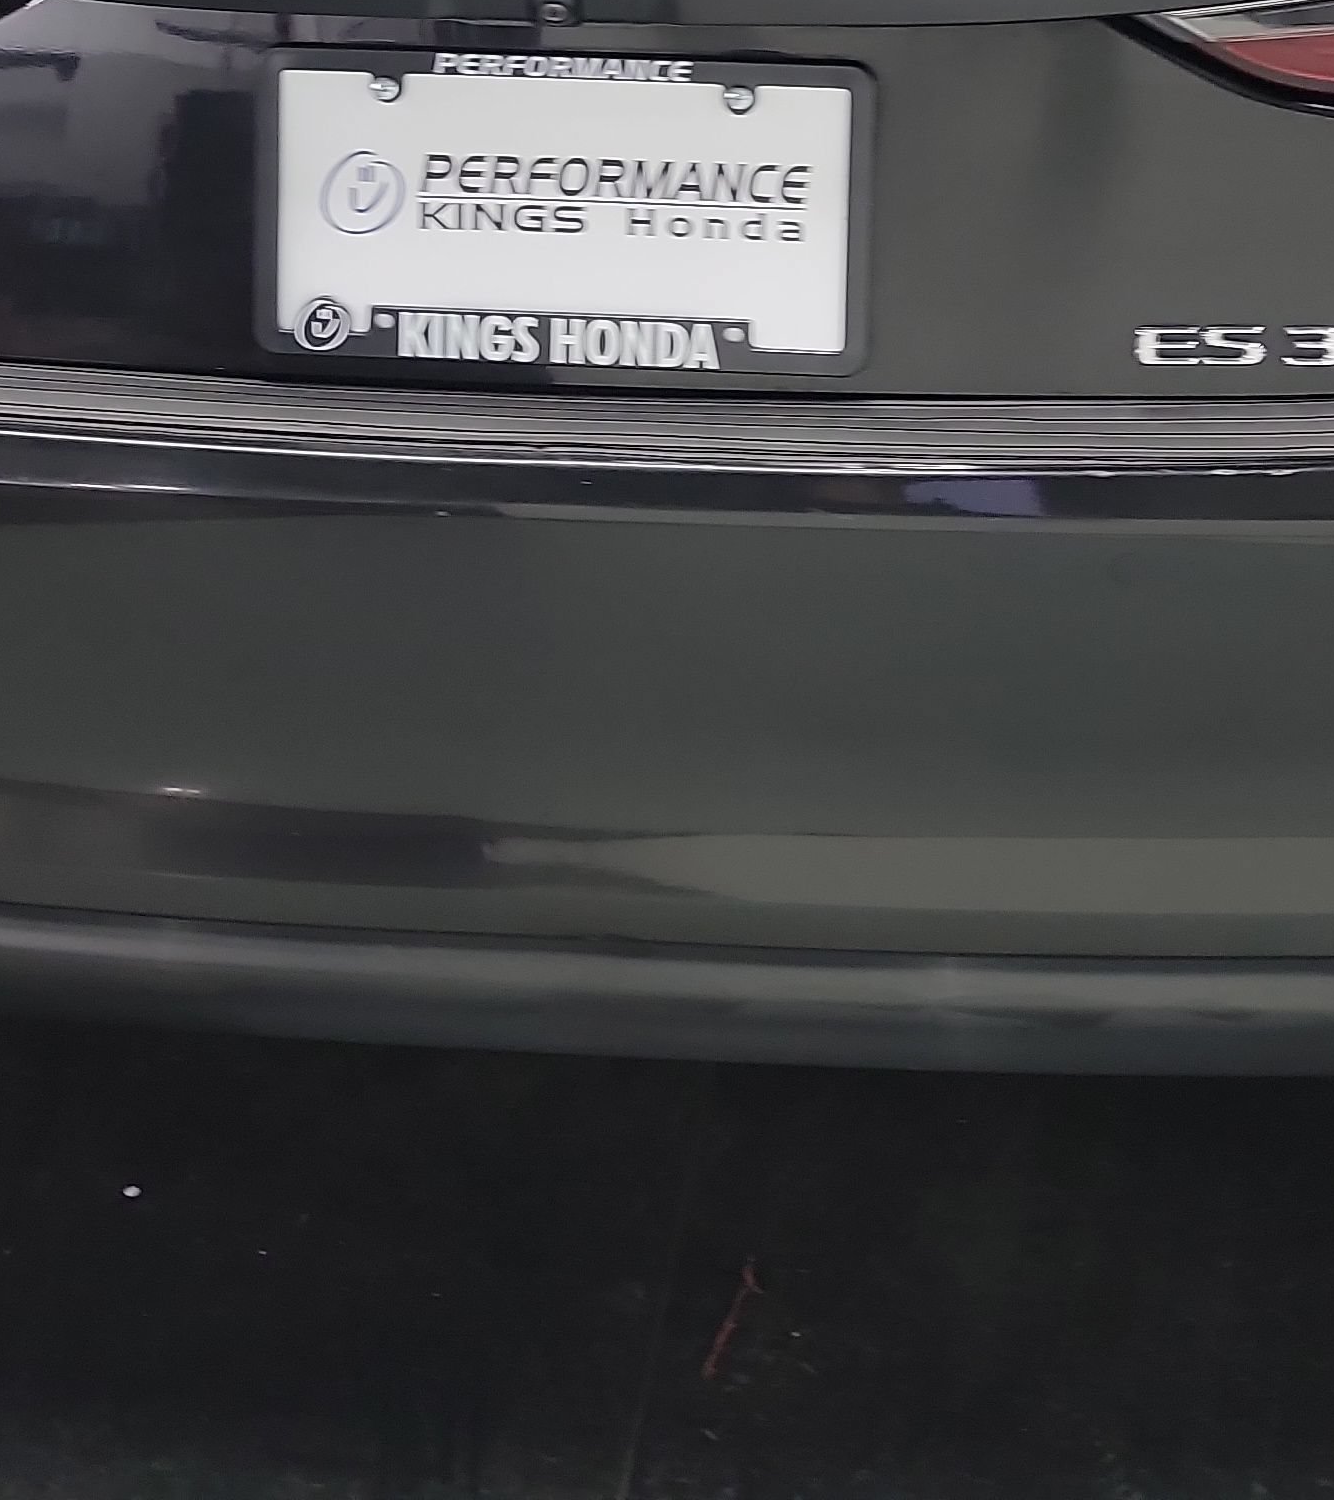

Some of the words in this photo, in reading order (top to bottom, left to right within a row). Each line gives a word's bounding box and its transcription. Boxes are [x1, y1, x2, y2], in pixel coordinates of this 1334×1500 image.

[432, 53, 695, 82] PERFORMANCE
[421, 153, 813, 204] PERFORMANCE
[420, 204, 586, 234] KINGS
[627, 208, 806, 242] Honda
[396, 311, 540, 364] KINGS
[549, 317, 722, 370] HONDA
[1133, 325, 1268, 366] ES
